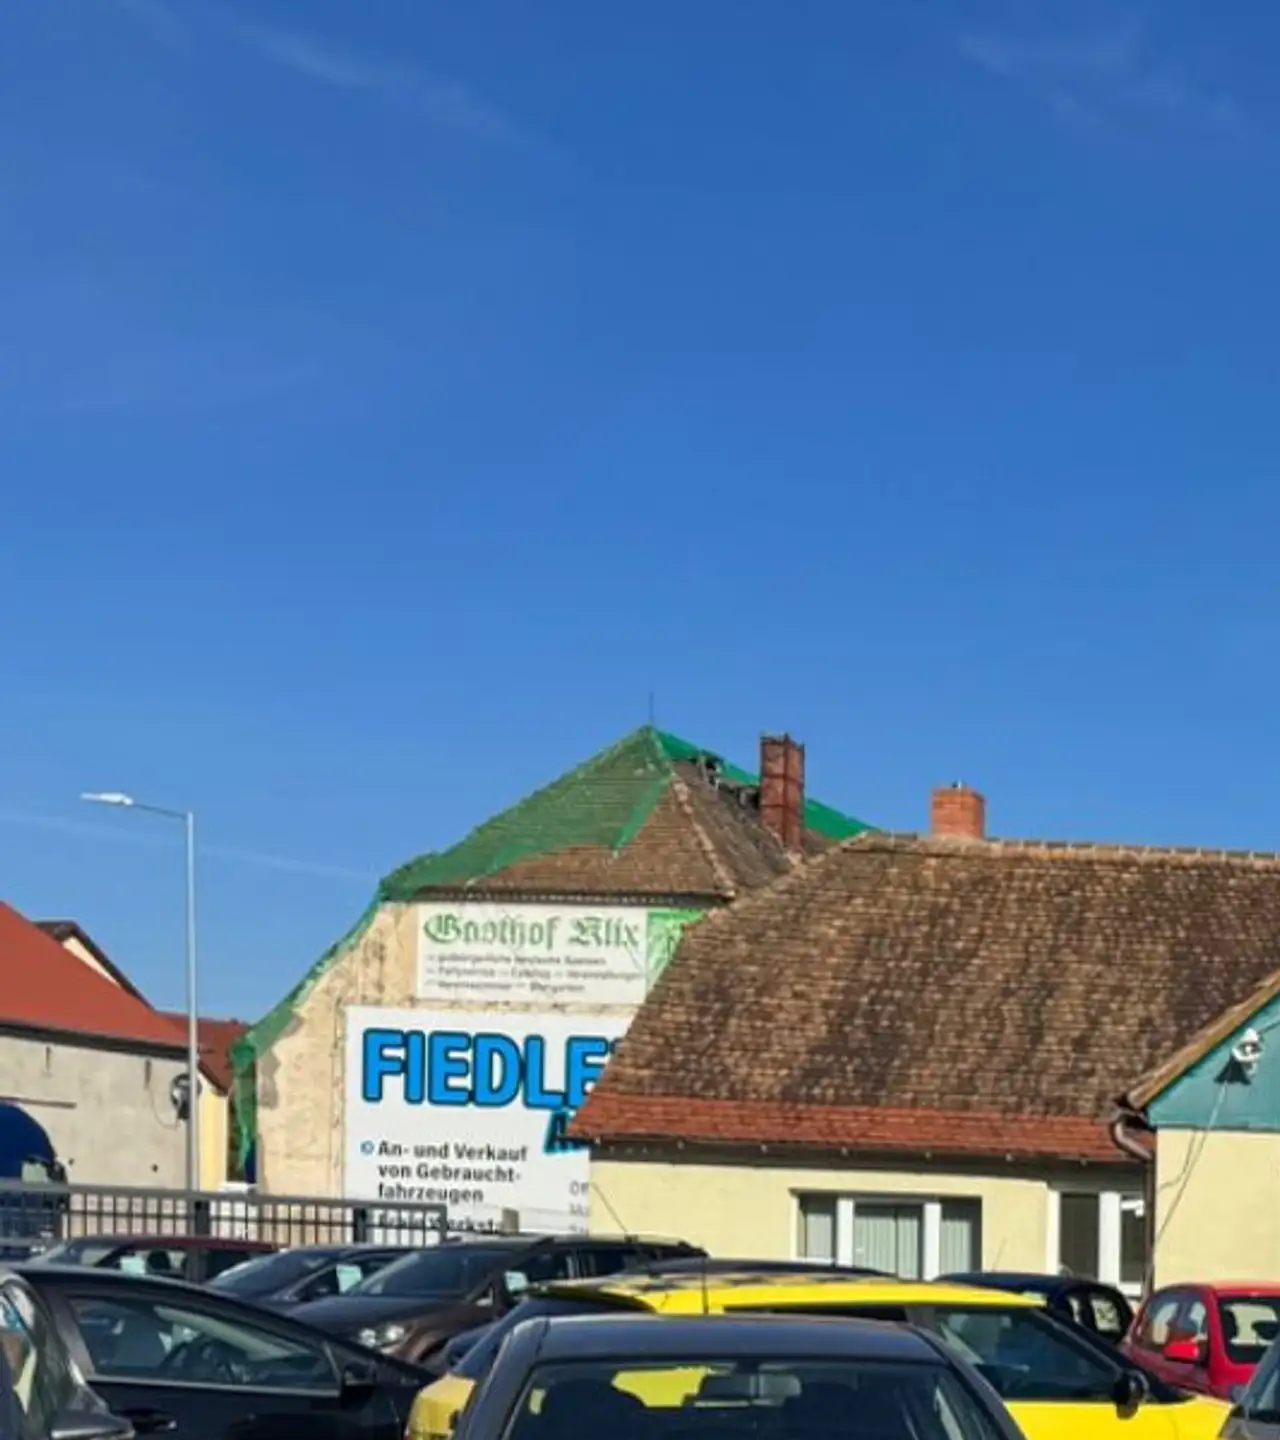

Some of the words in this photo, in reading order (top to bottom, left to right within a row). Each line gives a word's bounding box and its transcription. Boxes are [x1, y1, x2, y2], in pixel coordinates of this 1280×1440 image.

[423, 912, 561, 950] Gasthof
[362, 1027, 620, 1110] FIEDLE
[377, 1140, 409, 1158] An-
[413, 1143, 449, 1159] und
[453, 1144, 528, 1162] Verkauf
[378, 1164, 411, 1179] von
[416, 1163, 521, 1183] Gebraucht-
[377, 1183, 484, 1204] fahrzeugen
